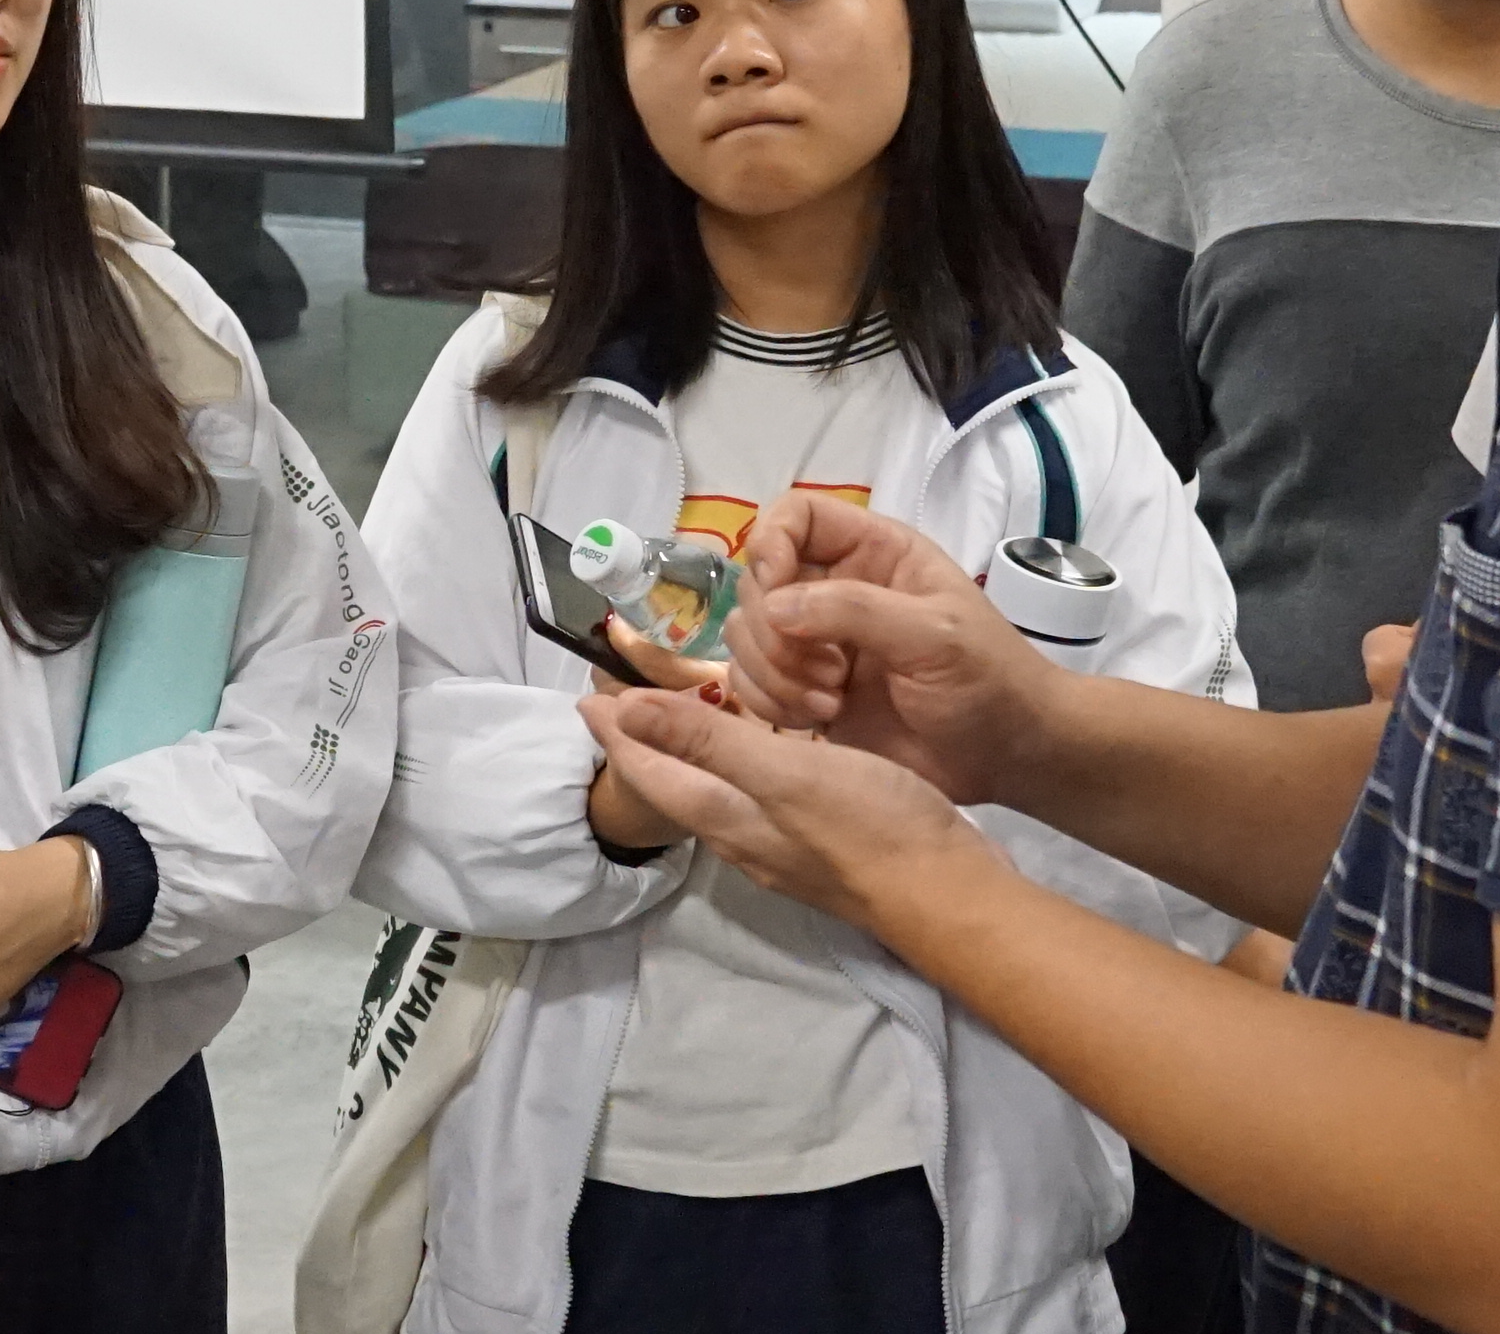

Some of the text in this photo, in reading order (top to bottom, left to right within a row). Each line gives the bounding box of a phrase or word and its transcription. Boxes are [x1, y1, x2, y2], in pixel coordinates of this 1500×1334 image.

[306, 494, 366, 623] Jiaotong
[338, 632, 371, 675] Gao
[376, 928, 462, 1091] MPANY
